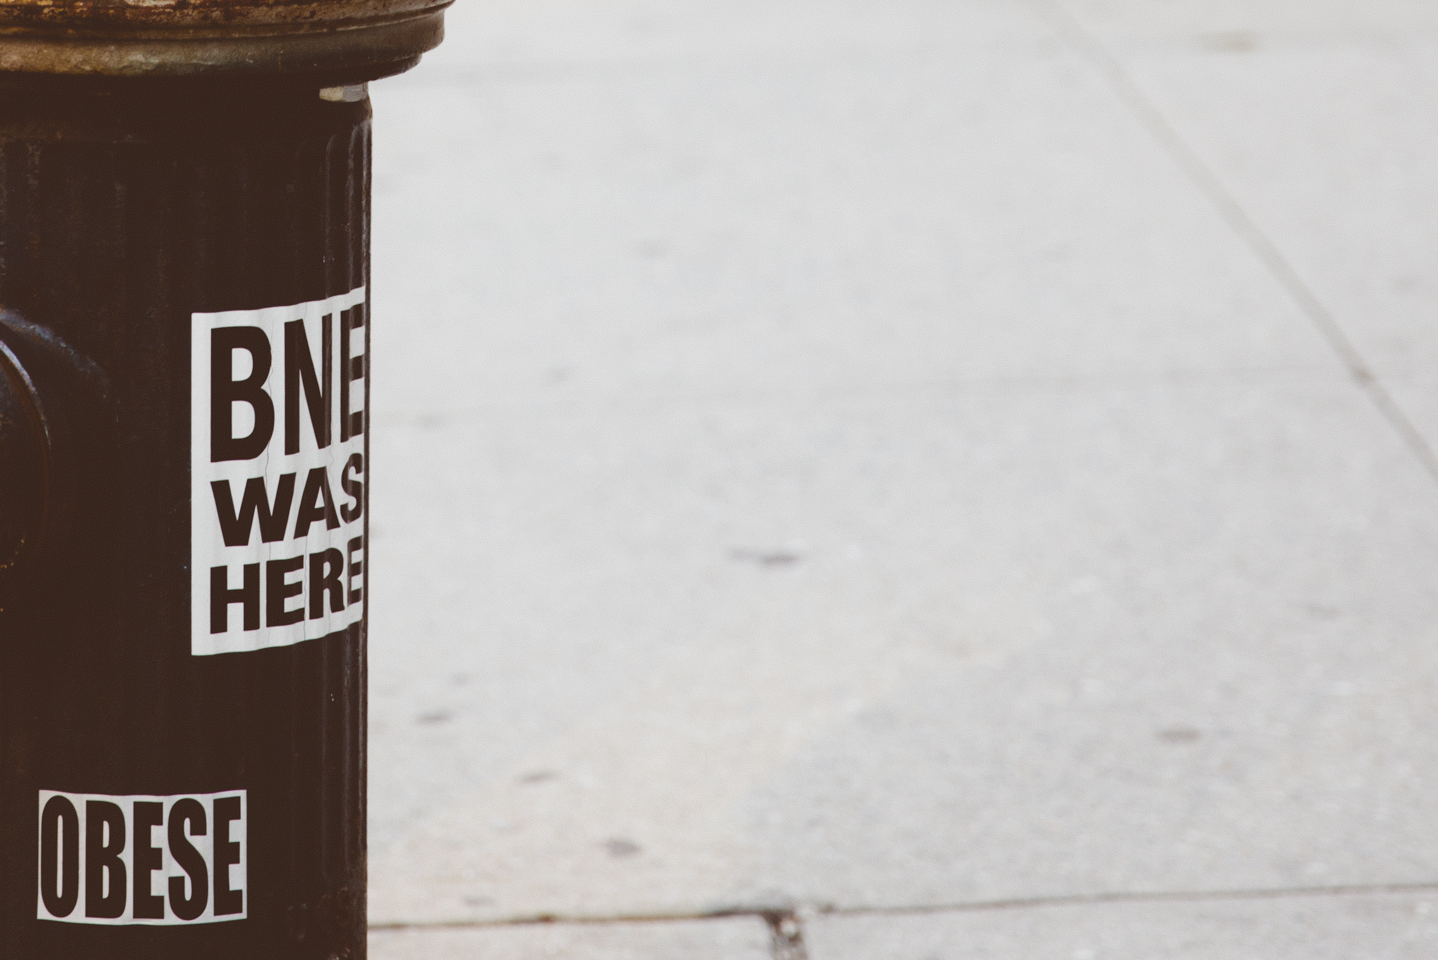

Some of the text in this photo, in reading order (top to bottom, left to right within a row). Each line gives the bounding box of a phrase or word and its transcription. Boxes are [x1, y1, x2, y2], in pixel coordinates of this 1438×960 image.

[210, 303, 365, 463] BNE
[210, 452, 363, 547] WAS
[210, 536, 363, 634] HERE
[40, 794, 244, 921] OBESE
